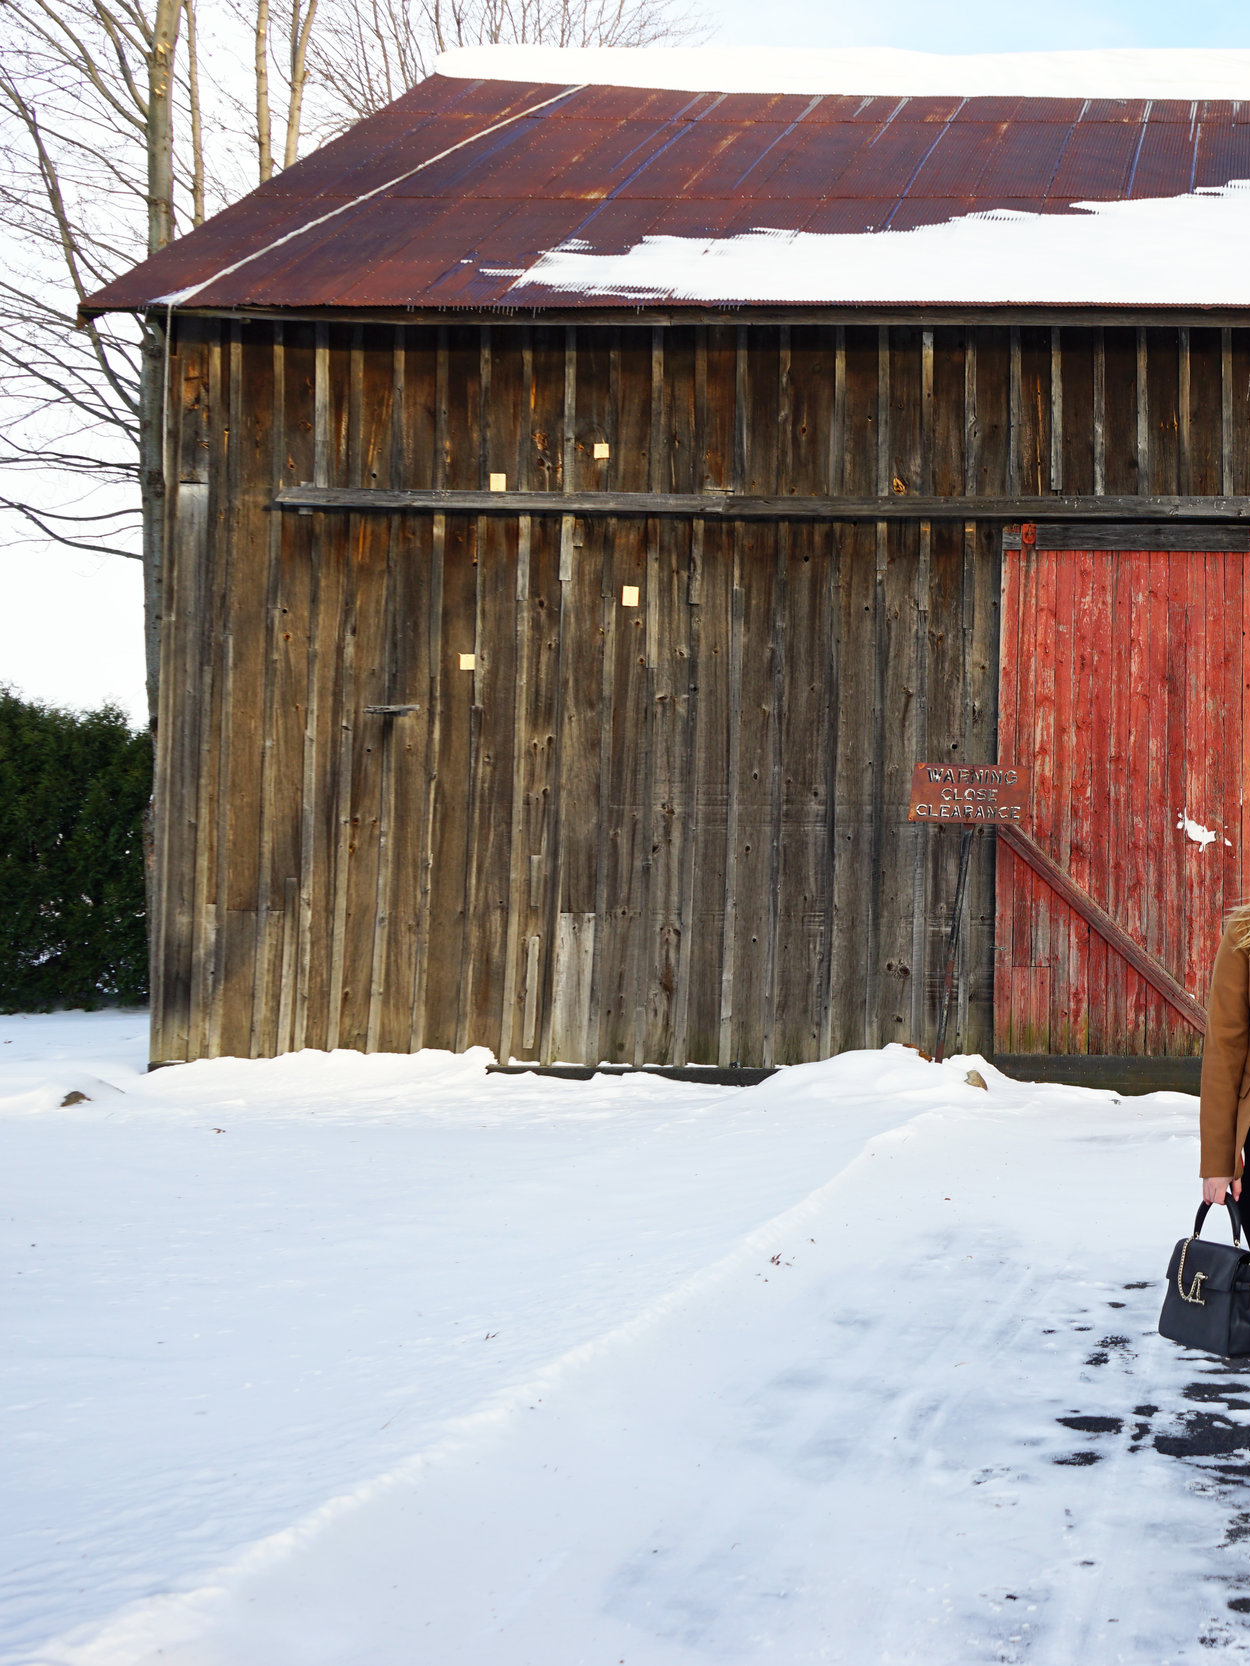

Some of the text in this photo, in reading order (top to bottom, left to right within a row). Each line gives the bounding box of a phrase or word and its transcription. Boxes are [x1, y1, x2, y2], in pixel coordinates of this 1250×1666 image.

[927, 768, 1018, 785] WARNING
[941, 788, 998, 801] CLOSE
[916, 804, 1021, 819] CLEARANCE
